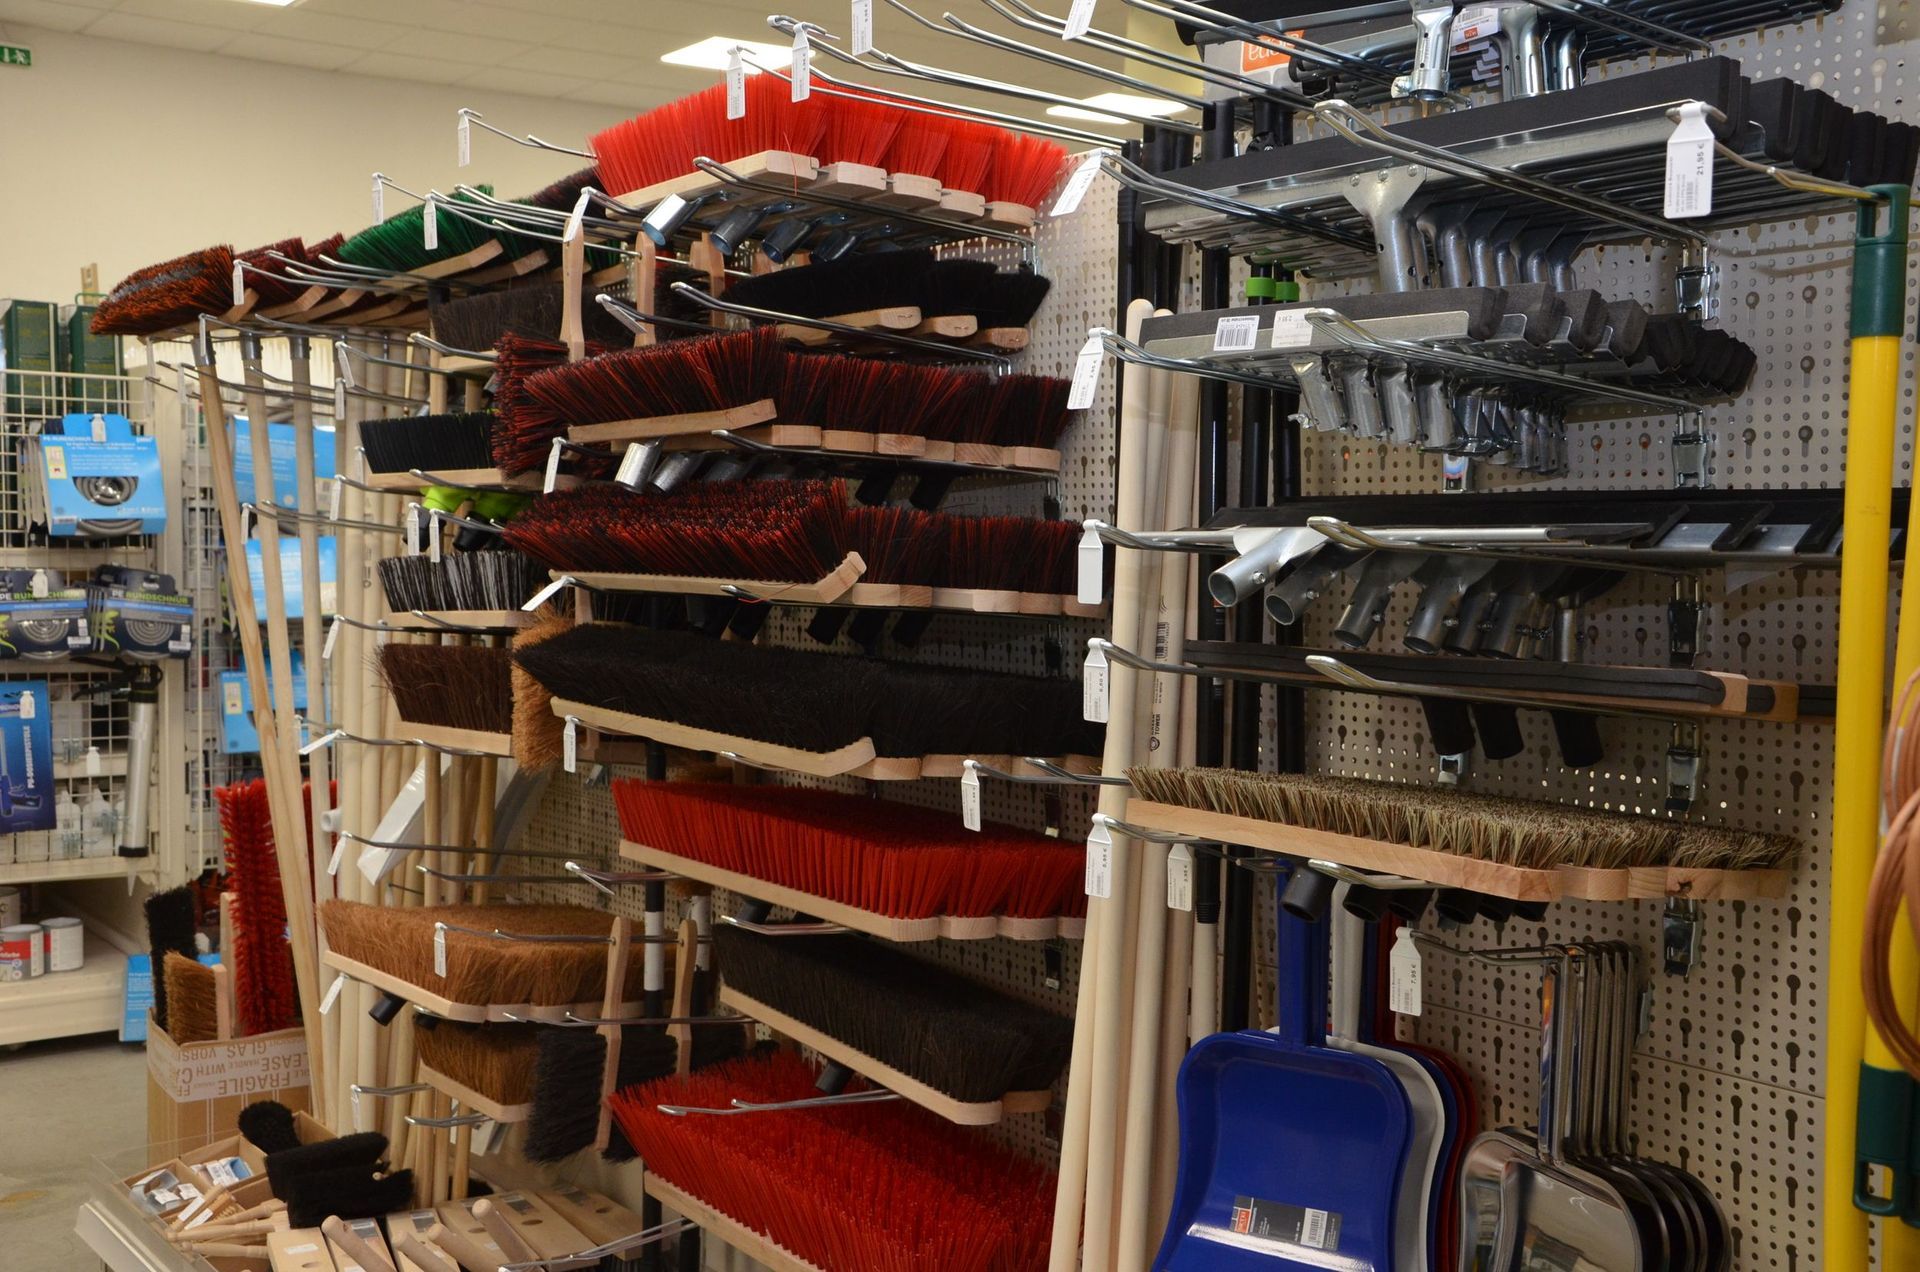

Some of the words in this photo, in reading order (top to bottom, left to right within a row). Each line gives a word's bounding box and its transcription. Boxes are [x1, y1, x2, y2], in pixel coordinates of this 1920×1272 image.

[1696, 152, 1705, 175] 21,95
[125, 591, 188, 604] RUNDSCHNUR
[226, 1040, 267, 1059] GLAS
[196, 1062, 226, 1078] WITH
[218, 1071, 291, 1095] FRAGILE
